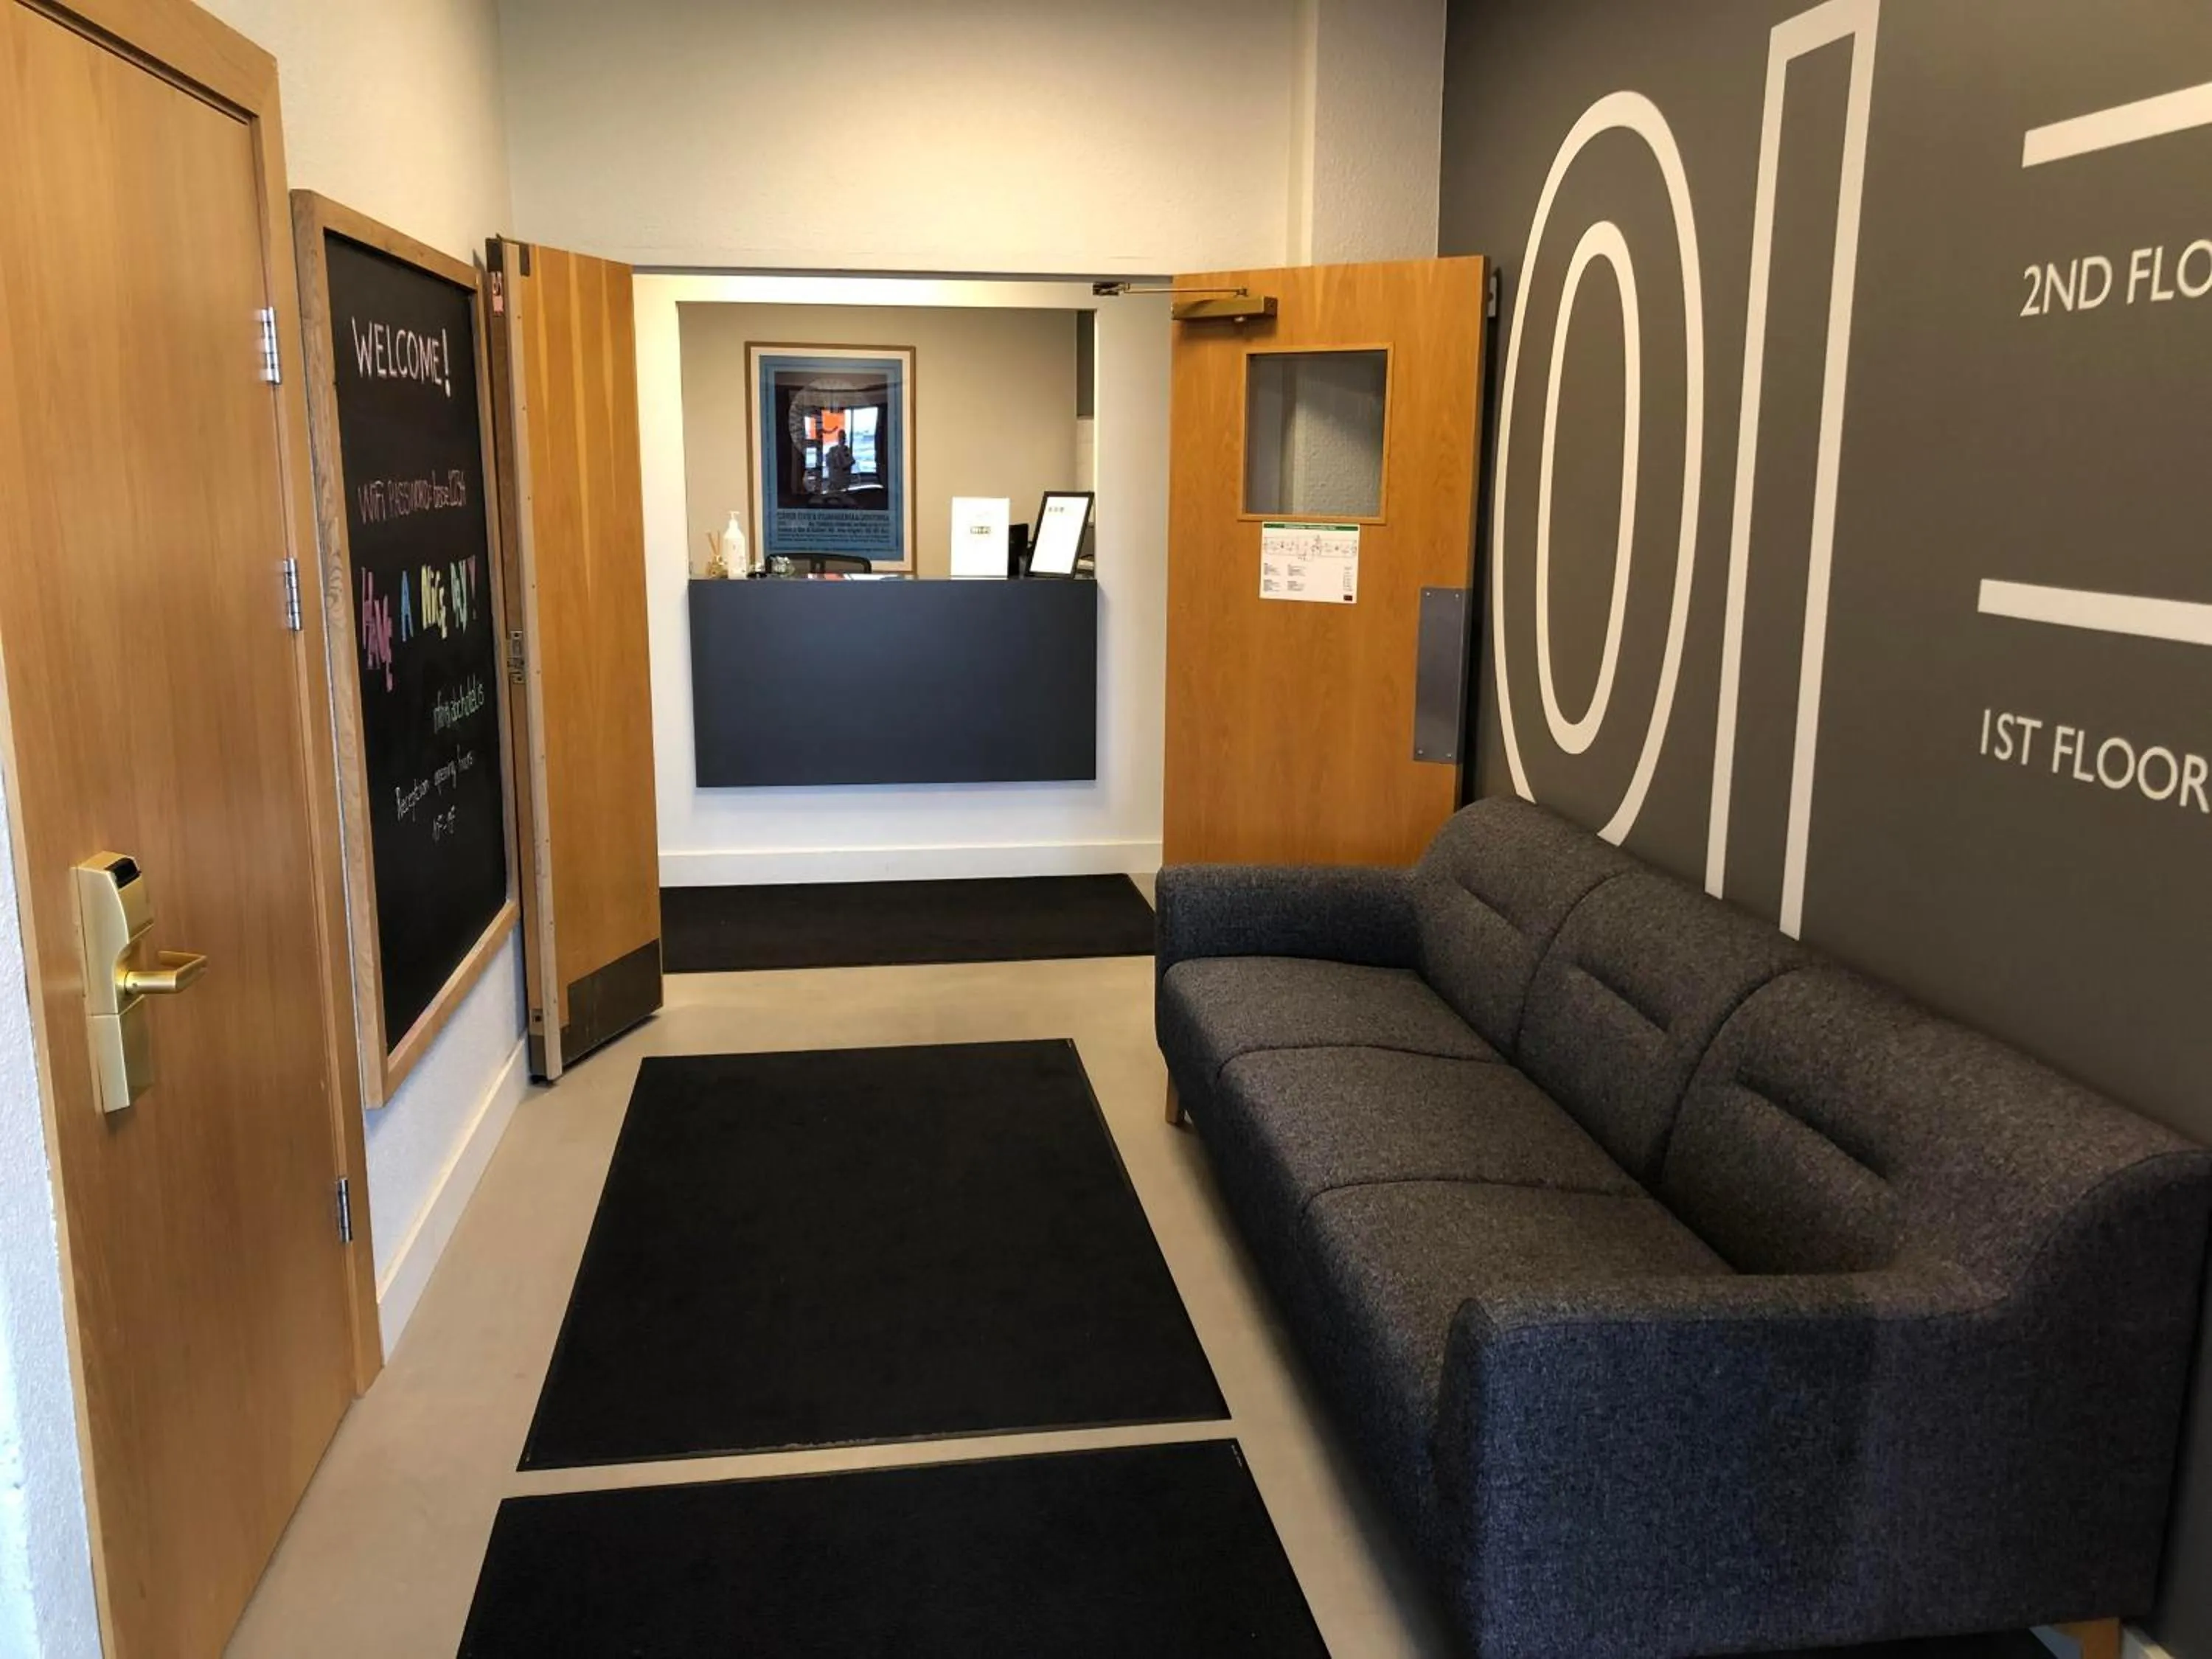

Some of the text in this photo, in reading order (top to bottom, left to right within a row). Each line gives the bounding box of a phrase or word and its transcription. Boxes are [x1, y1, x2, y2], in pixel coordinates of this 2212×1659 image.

[2020, 255, 2112, 317] 2ND
[352, 316, 451, 397] WELCOME!
[400, 570, 414, 642] A
[2052, 725, 2211, 814] FLOOR
